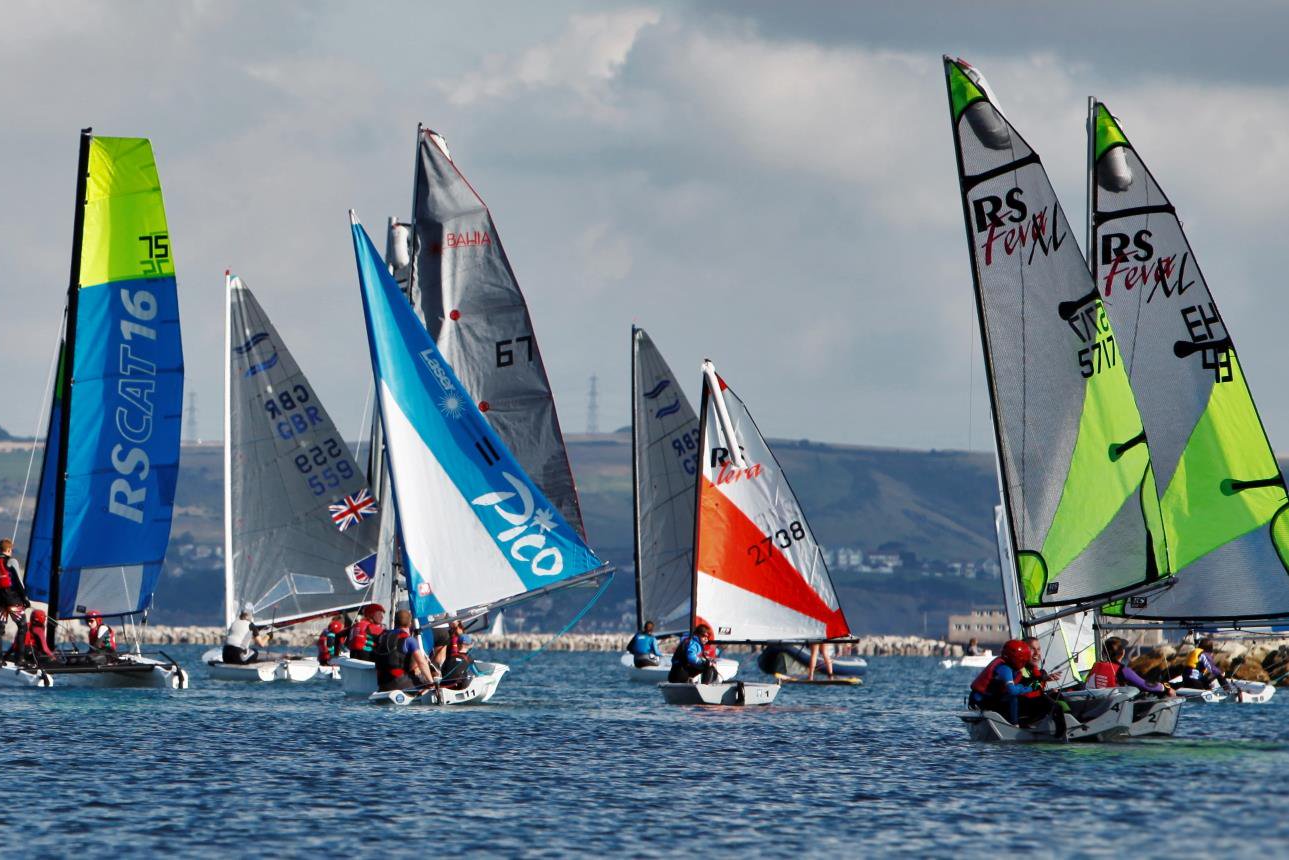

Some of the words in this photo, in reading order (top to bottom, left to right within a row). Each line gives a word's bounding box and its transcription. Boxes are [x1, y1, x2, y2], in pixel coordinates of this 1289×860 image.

[973, 187, 1027, 233] RS
[138, 235, 169, 259] 75
[446, 231, 492, 248] BAHIA
[1102, 229, 1154, 265] RS
[496, 335, 533, 368] 67
[1077, 335, 1116, 379] 5717
[417, 349, 456, 391] Laser
[277, 405, 324, 440] GBR
[307, 459, 354, 497] 559
[472, 471, 563, 577] Pico
[746, 521, 806, 567] 2738
[1110, 702, 1120, 713] 4
[1148, 712, 1156, 723] 2
